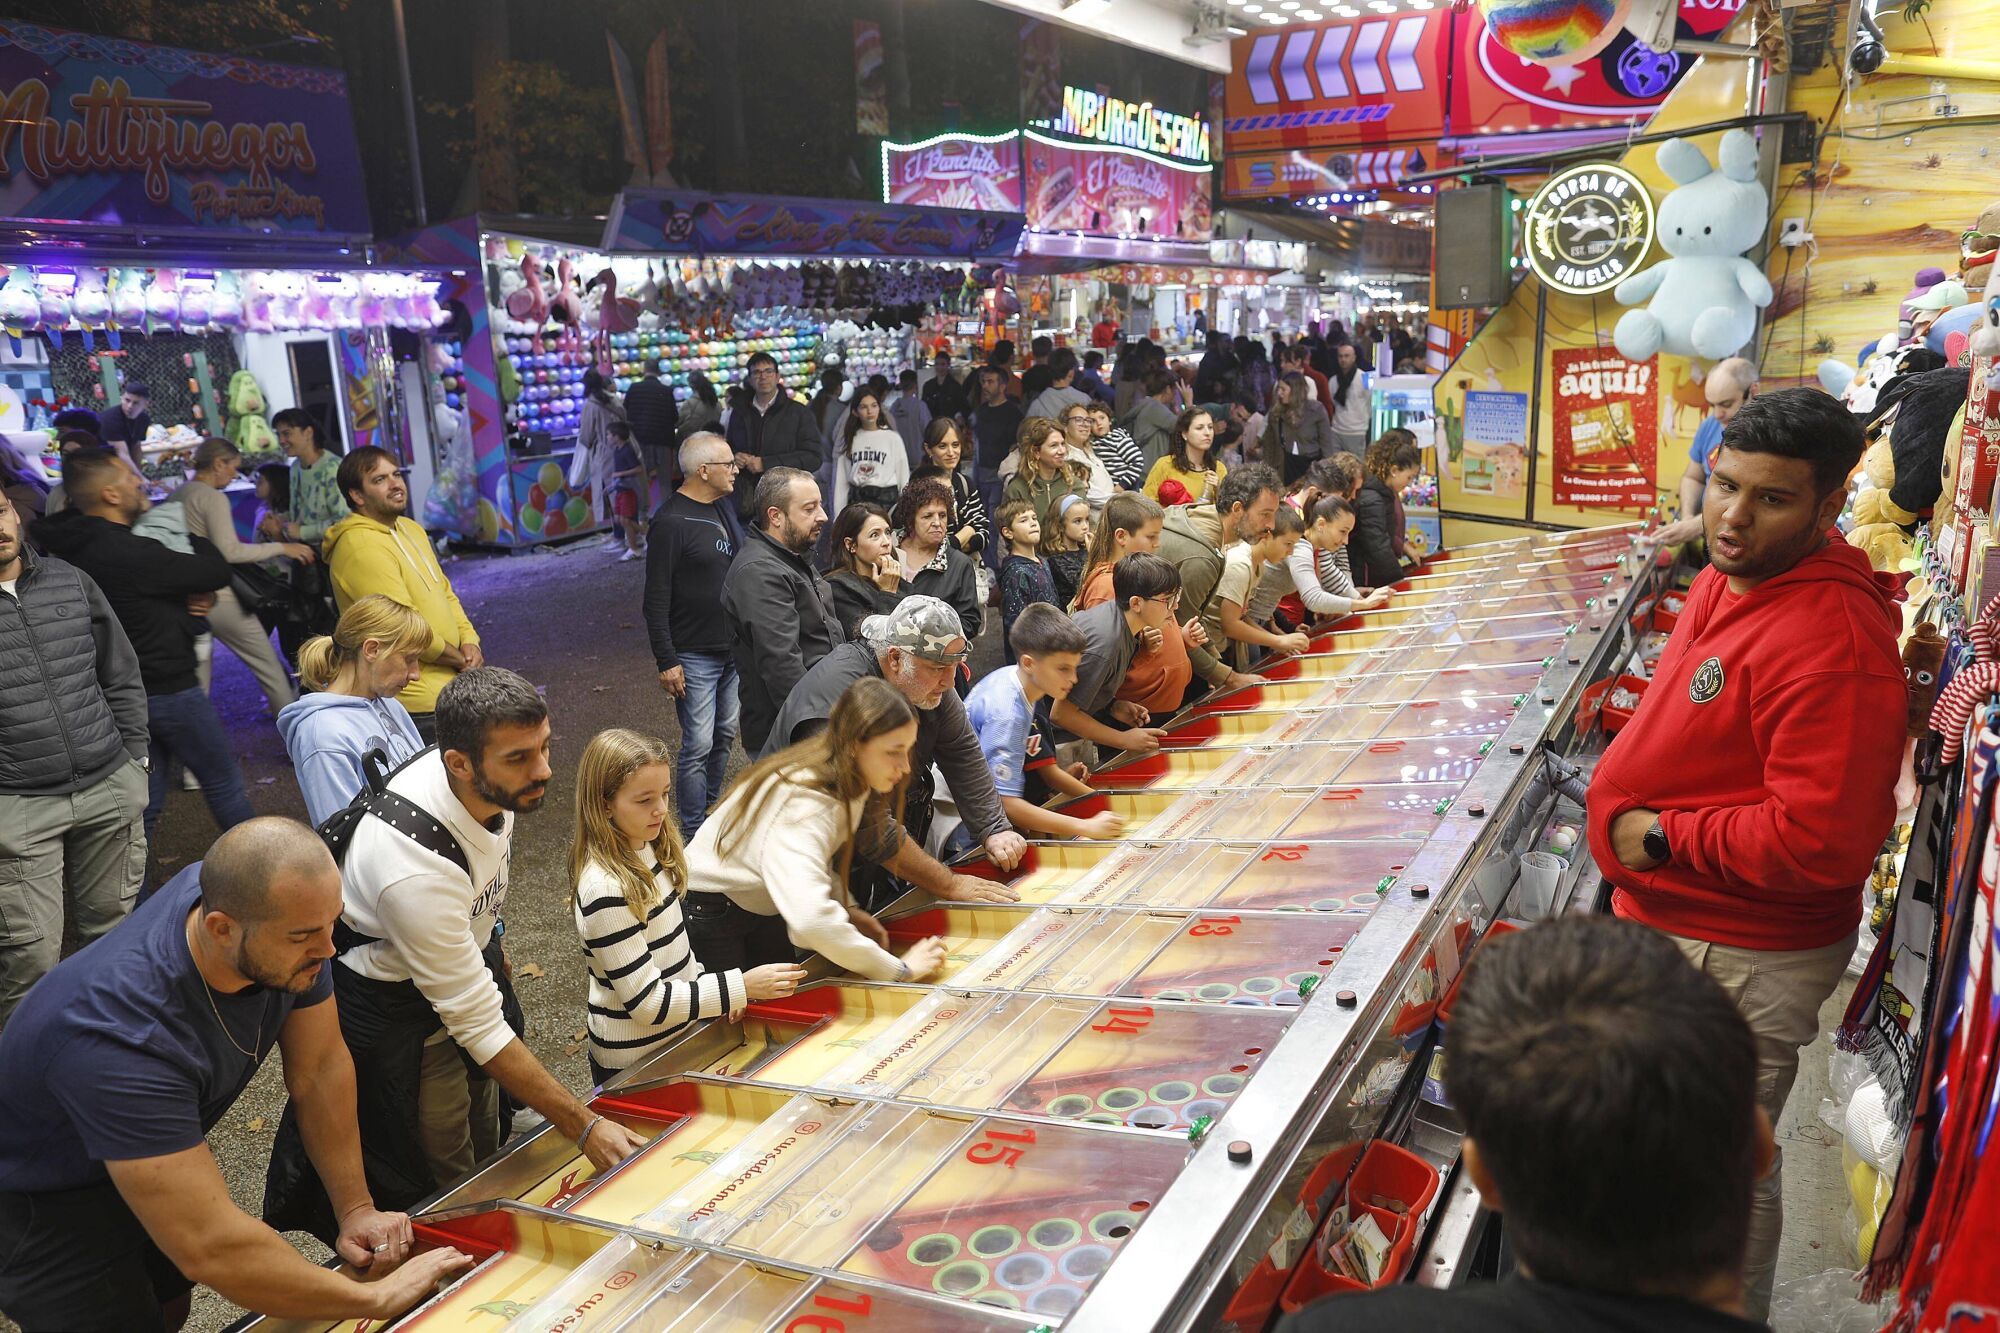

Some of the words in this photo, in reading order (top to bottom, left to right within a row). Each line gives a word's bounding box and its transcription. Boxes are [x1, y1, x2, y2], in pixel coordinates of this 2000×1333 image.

[904, 152, 924, 183] El
[925, 144, 1001, 180] Panchito
[1086, 156, 1105, 194] El
[1107, 157, 1168, 199] Panchito
[1548, 174, 1599, 206] CURSA
[1603, 176, 1629, 198] DE
[1554, 258, 1623, 287] CAMELLS
[1559, 364, 1651, 400] aquí!
[1321, 788, 1364, 800] 11
[1261, 844, 1311, 862] 12
[1189, 915, 1241, 937] 13
[982, 931, 1048, 983] cursadecamells
[1092, 1006, 1155, 1034] 14
[855, 1021, 939, 1085] cursadecamells
[966, 1128, 1037, 1169] 15
[687, 1136, 797, 1223] cursadecamells
[784, 1293, 873, 1333] 16
